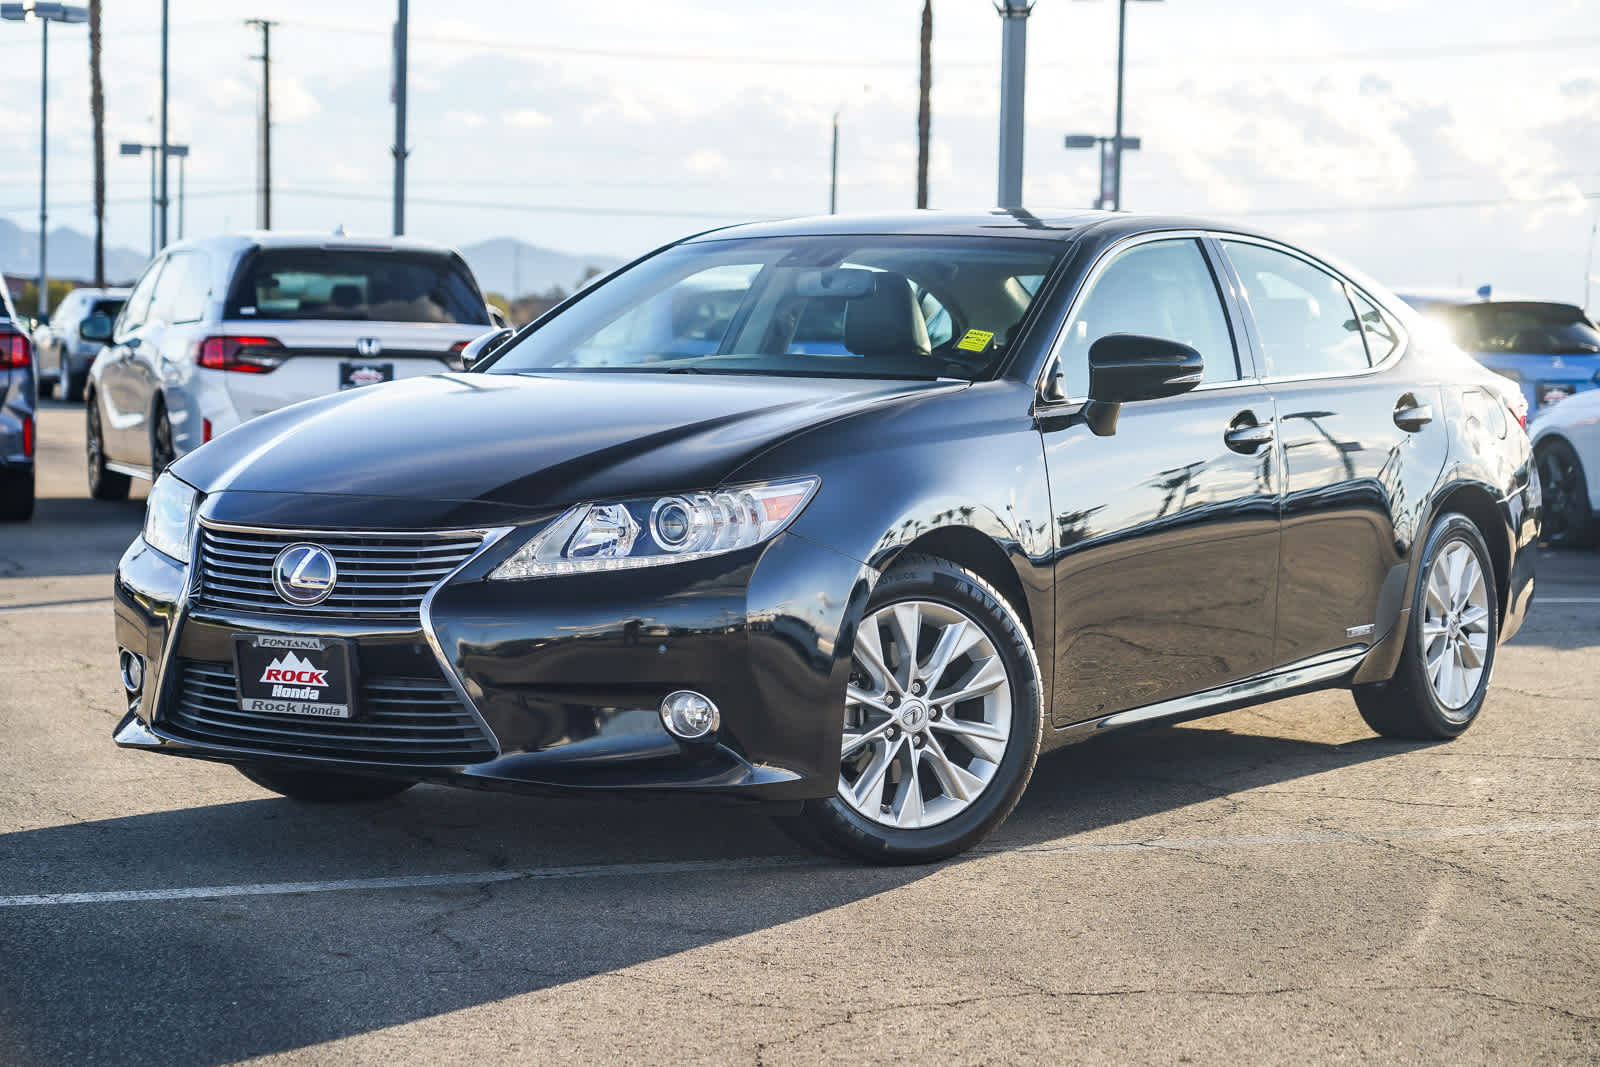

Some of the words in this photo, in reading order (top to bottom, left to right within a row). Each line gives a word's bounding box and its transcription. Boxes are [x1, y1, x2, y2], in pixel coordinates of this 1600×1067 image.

[260, 638, 319, 649] FONTANA
[265, 669, 324, 684] ROCK
[271, 685, 320, 700] Honda
[251, 701, 297, 713] Rock
[301, 703, 341, 716] Honda
